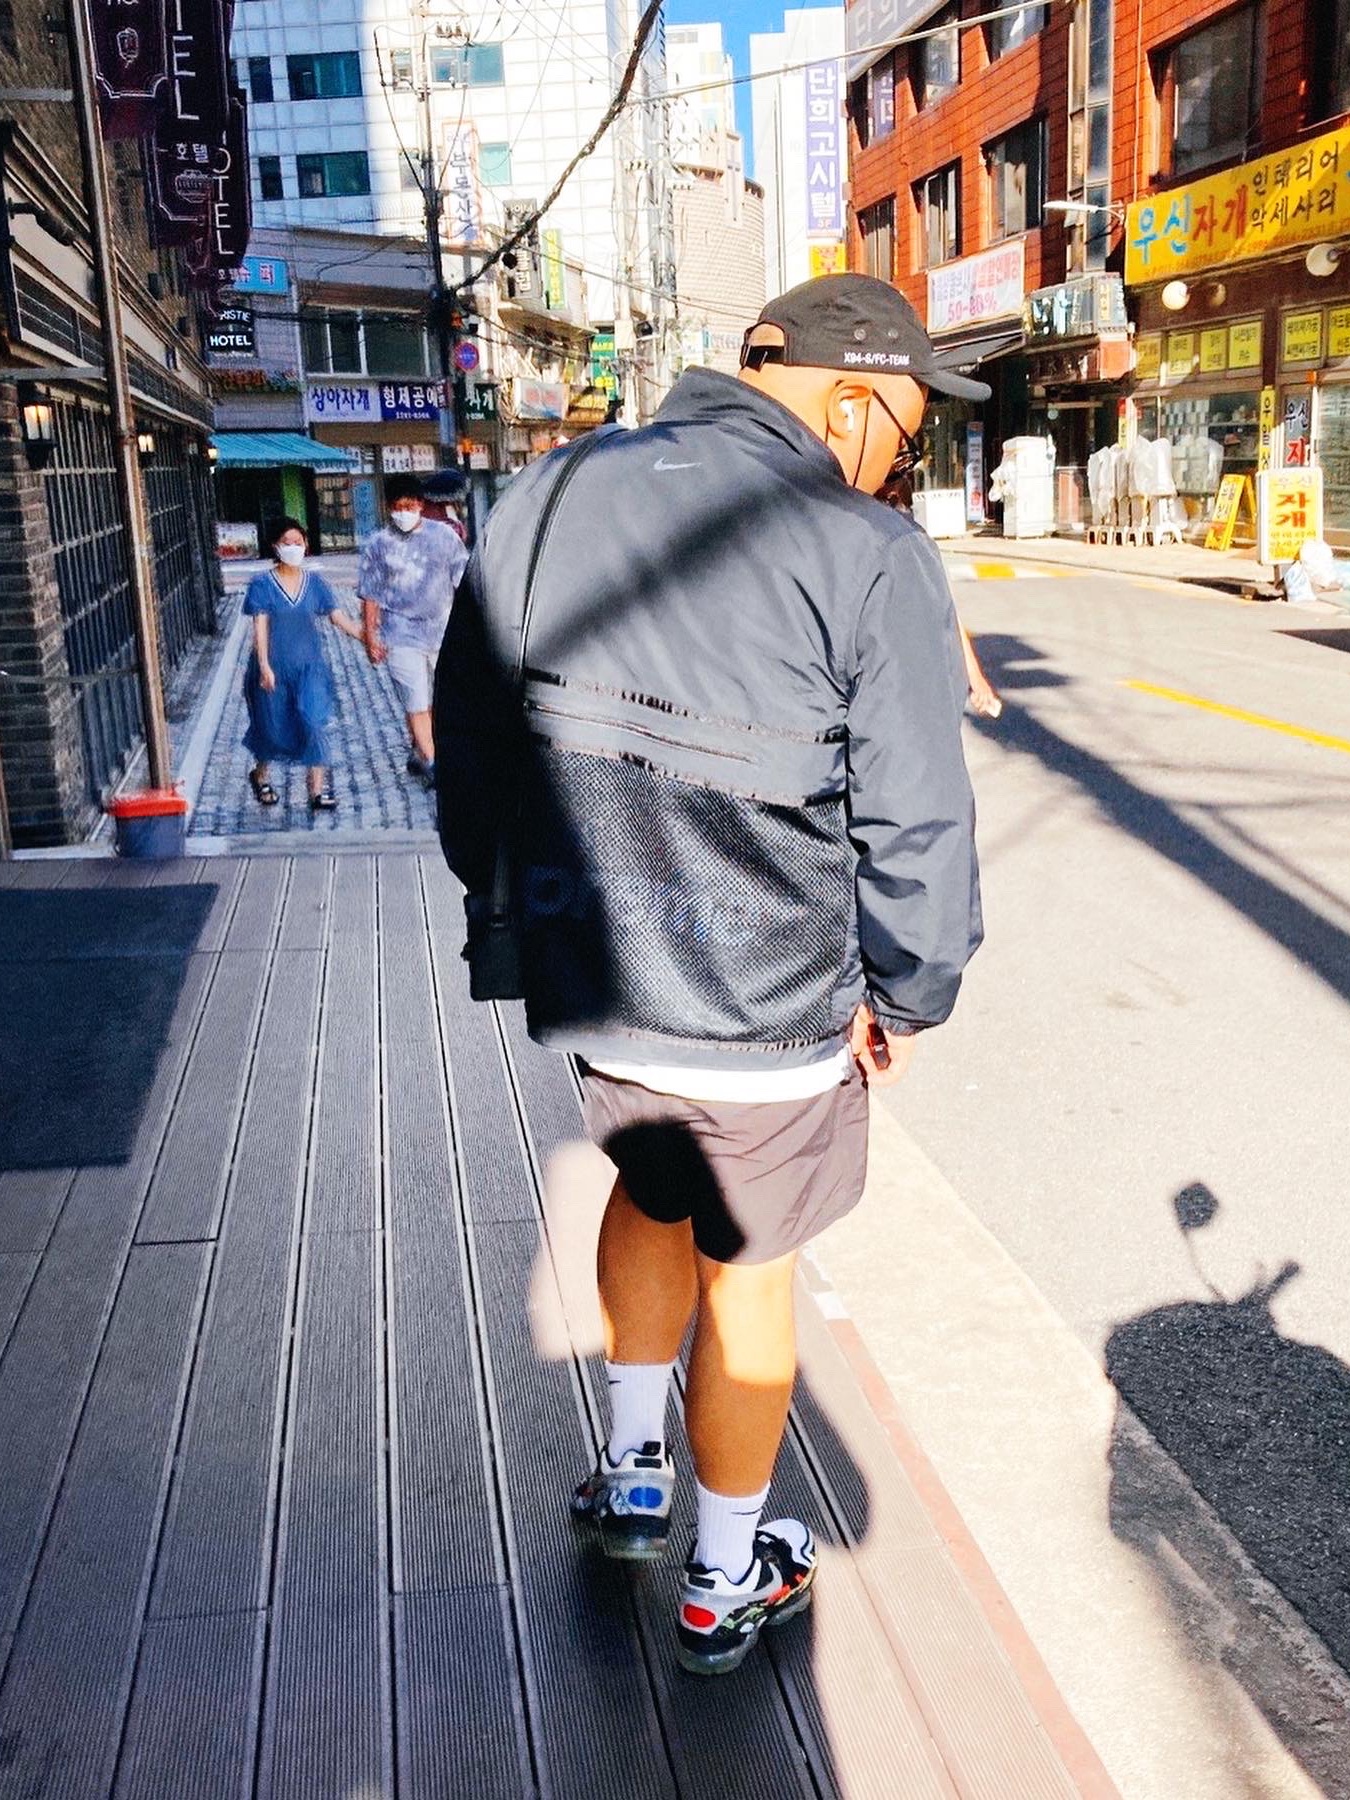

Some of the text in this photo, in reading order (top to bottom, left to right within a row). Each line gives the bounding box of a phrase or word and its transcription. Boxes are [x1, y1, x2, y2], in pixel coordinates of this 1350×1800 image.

[175, 142, 209, 163] 호텔
[808, 67, 838, 218] 단희고시텔
[1251, 182, 1337, 232] 악세사리
[209, 334, 253, 347] HOTEL
[1284, 401, 1309, 431] 우신
[1275, 491, 1312, 529] 자개
